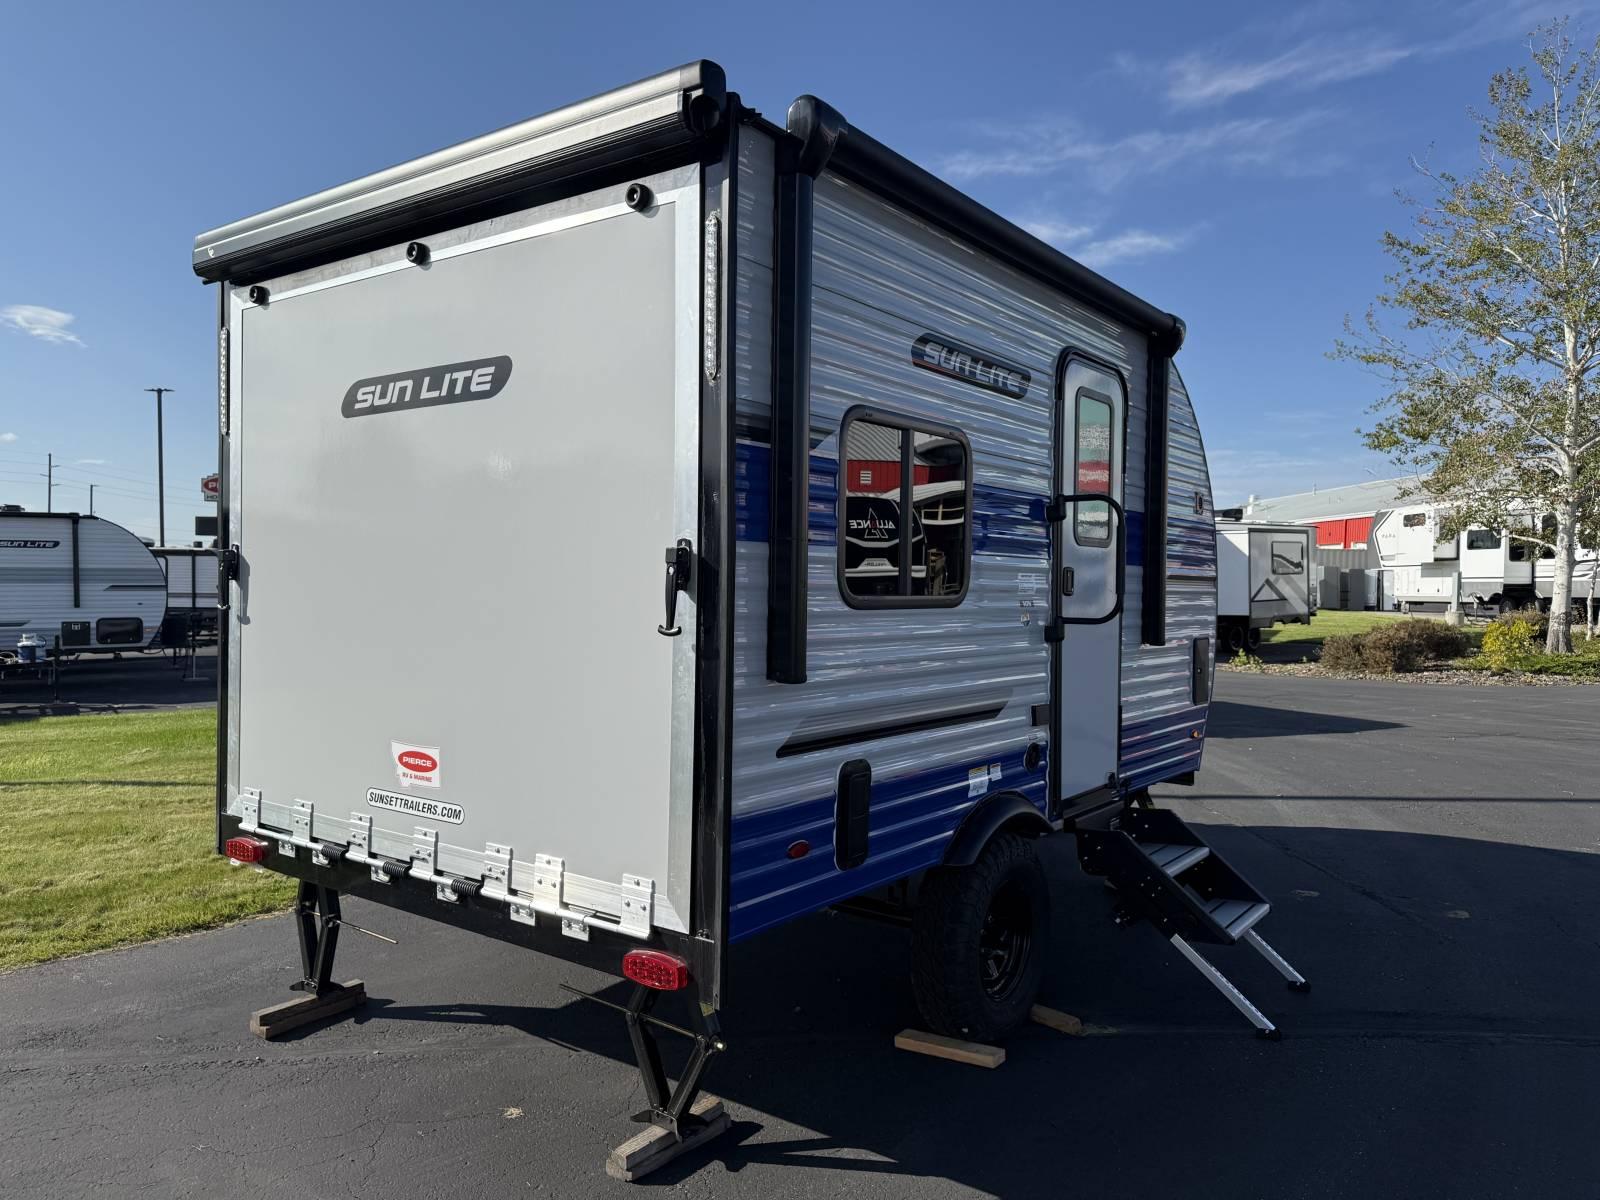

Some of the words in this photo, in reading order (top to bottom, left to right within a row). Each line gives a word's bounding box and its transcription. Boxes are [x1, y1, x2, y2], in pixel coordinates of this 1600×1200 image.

[923, 342, 972, 376] SUN
[975, 360, 1024, 392] LITE
[354, 379, 413, 410] SUN
[420, 366, 496, 399] LITE
[402, 756, 433, 768] PIERCE
[368, 791, 462, 821] SUNSETTRAILERS.COM
